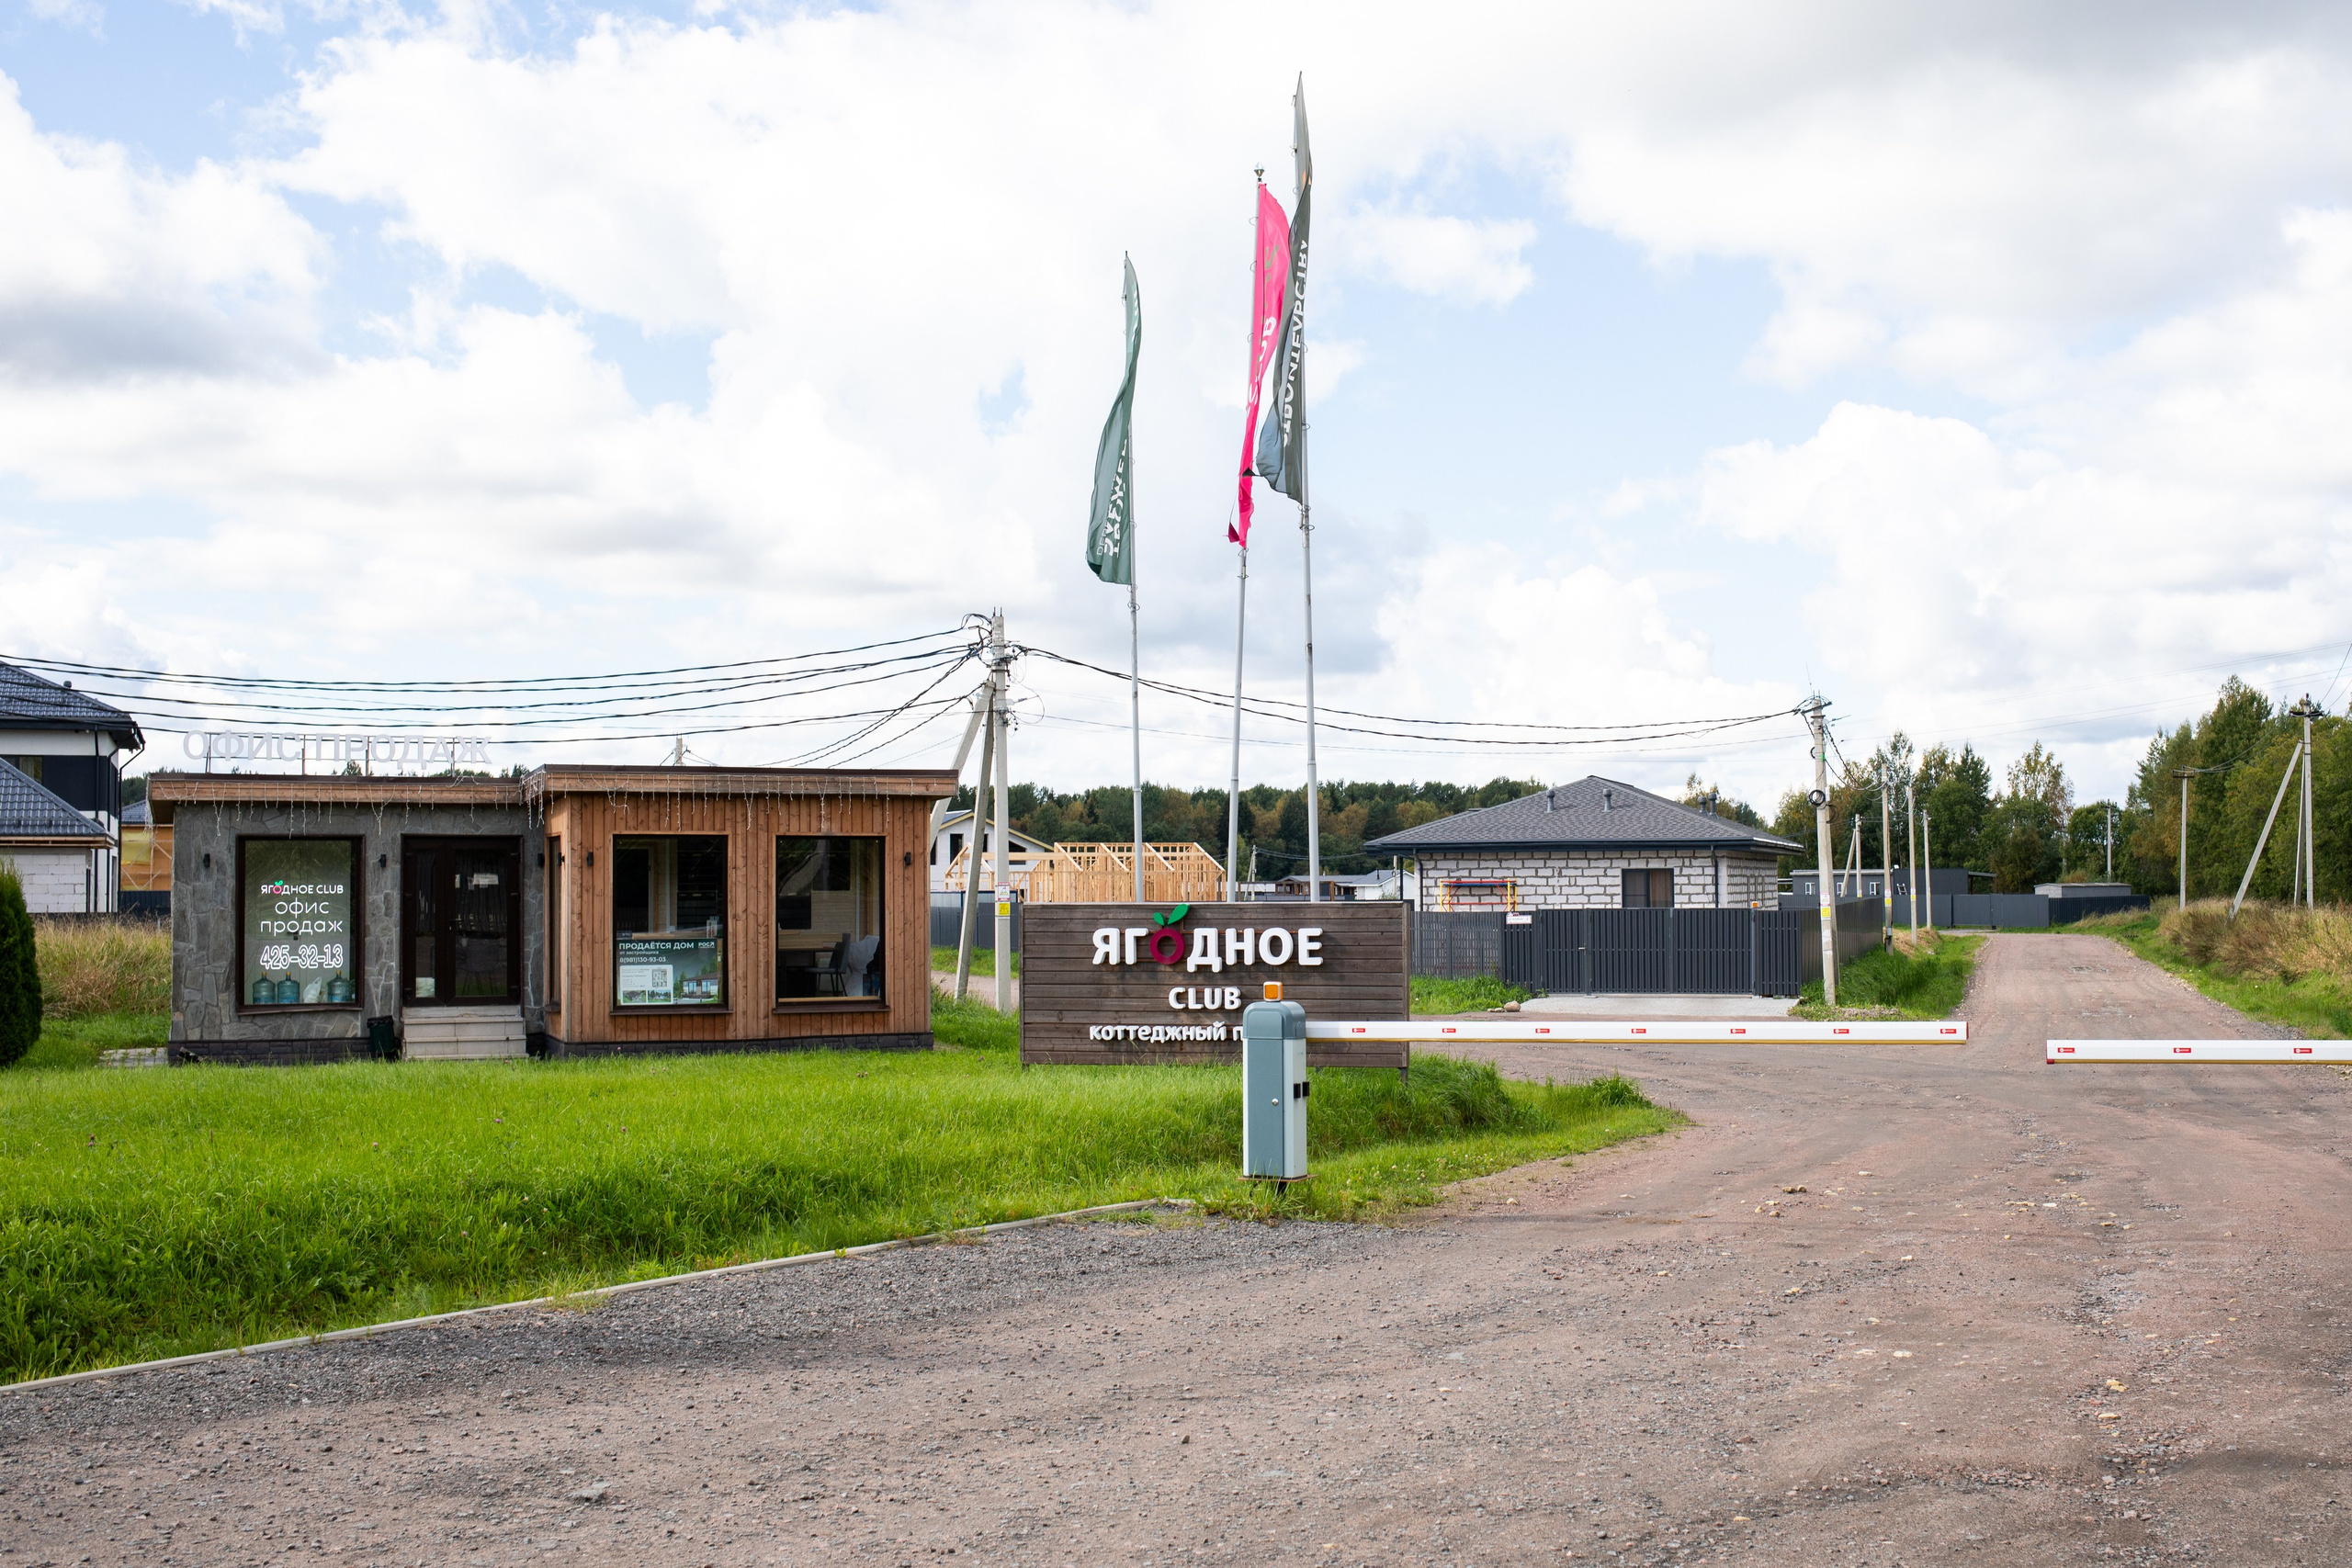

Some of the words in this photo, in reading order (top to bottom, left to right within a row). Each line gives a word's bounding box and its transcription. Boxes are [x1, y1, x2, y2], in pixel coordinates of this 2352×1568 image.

[183, 729, 301, 761] ОФИС
[315, 732, 492, 770] ПРОДАЖ
[260, 884, 314, 896] ЯГОДНОЕ
[316, 885, 345, 895] CLUB
[275, 897, 330, 919] офис
[260, 920, 344, 937] продаж
[260, 943, 344, 970] 425-32-13
[618, 942, 672, 950] ПРОДАЁТСЯ
[673, 942, 695, 950] ДОМ
[1091, 927, 1325, 973] ЯГОДНОЕ
[1168, 987, 1242, 1010] CLUB
[1089, 1021, 1227, 1043] коттеджный
